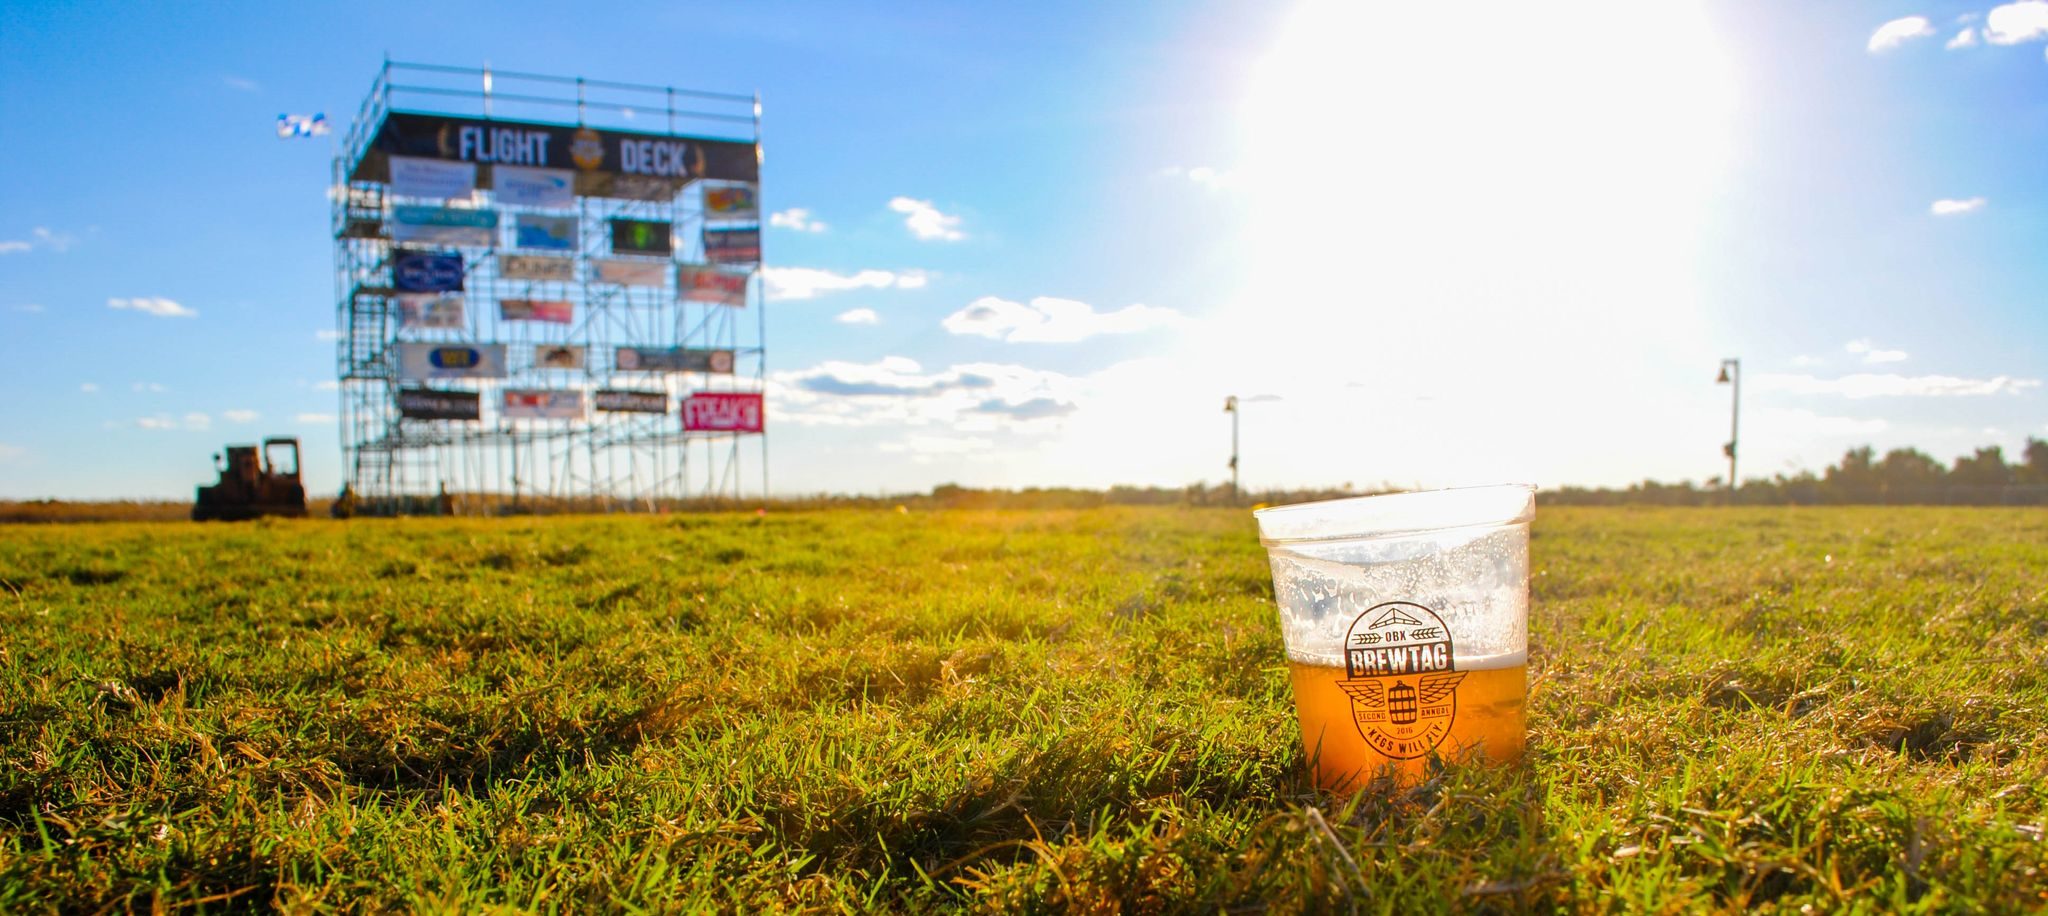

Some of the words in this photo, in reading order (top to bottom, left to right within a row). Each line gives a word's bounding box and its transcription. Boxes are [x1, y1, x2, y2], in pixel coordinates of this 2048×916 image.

[459, 126, 550, 167] FLIGHT
[620, 139, 688, 178] DECK
[1385, 631, 1407, 642] OBX
[1351, 643, 1448, 676] BREWTAG
[1359, 712, 1387, 720] SECOND
[1421, 706, 1449, 717] ANNUAL
[1367, 729, 1394, 751] KEGS
[1398, 739, 1425, 754] WILL
[1426, 724, 1442, 744] FLY
